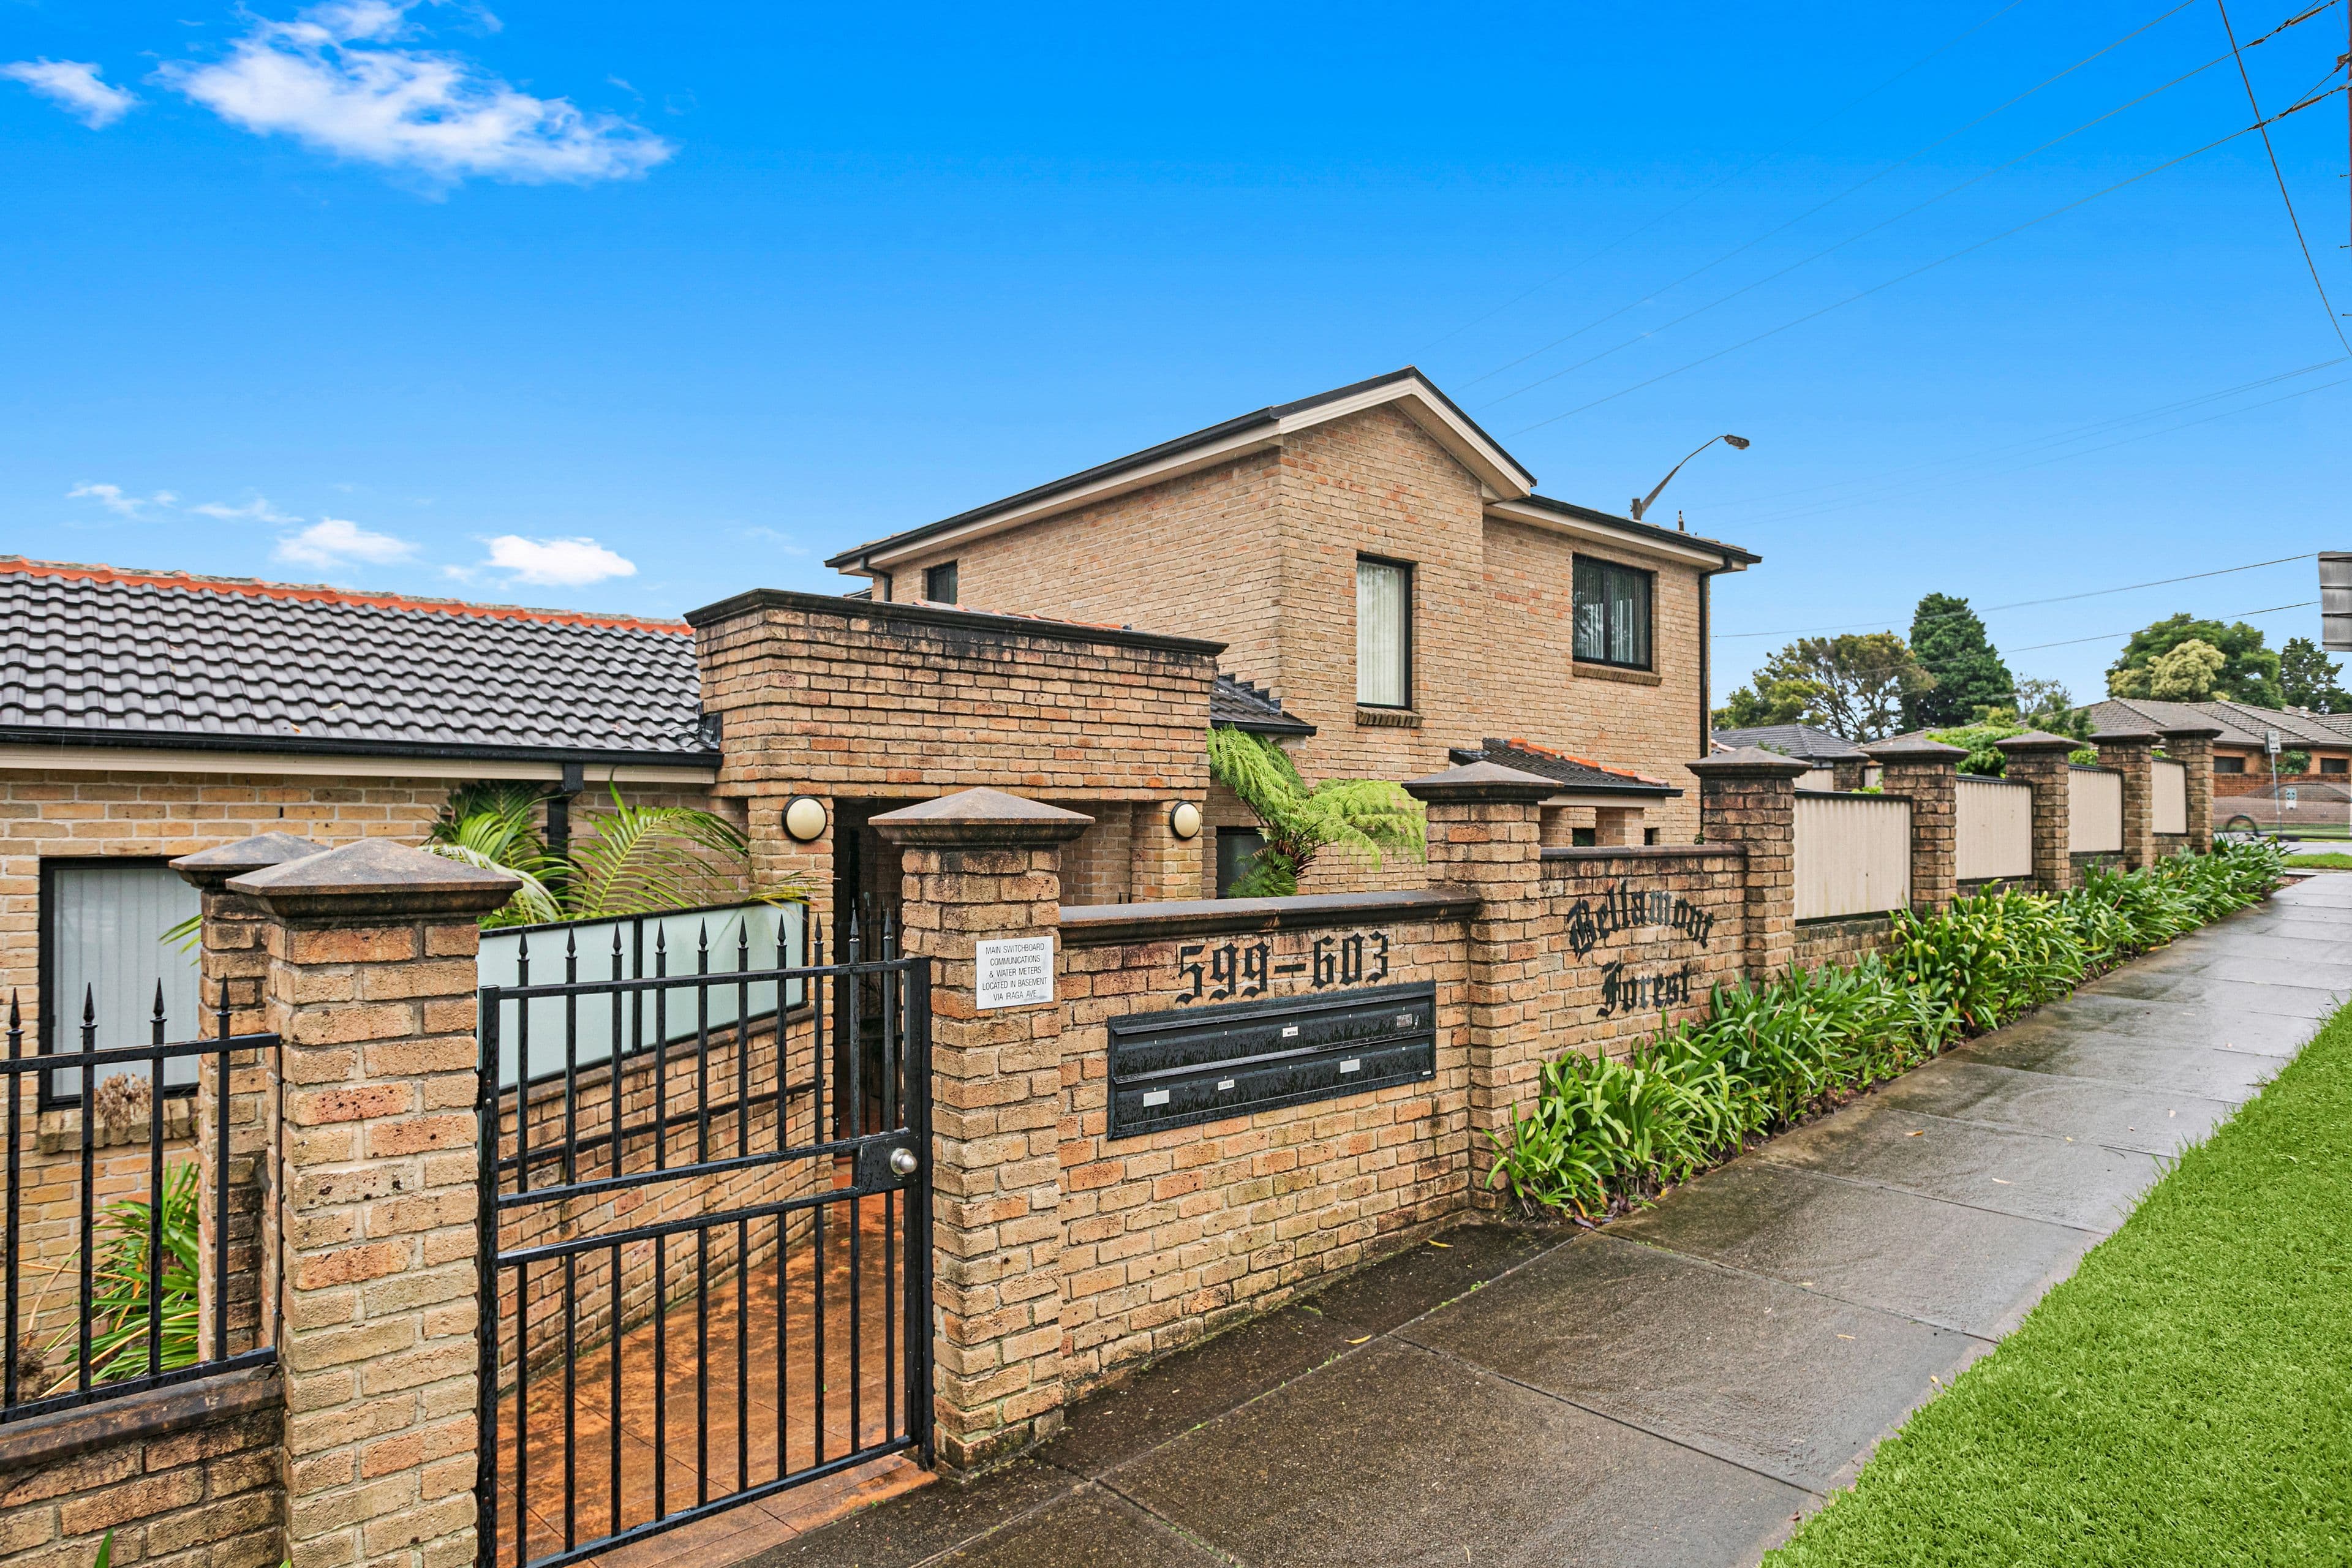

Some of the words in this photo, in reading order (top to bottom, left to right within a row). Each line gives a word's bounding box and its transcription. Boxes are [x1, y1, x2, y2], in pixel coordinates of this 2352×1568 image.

[986, 946, 1001, 954] MAIN
[1003, 943, 1044, 953] SWITCHBOARD
[990, 955, 1041, 966] COMMUNICATIONS
[1019, 967, 1041, 976] METERS
[1175, 930, 1389, 1005] 599-603
[982, 981, 1008, 990] LOCATED
[1018, 977, 1047, 987] BASEMENT
[1596, 960, 1691, 1017] Forest
[1006, 991, 1023, 1000] IRAGA
